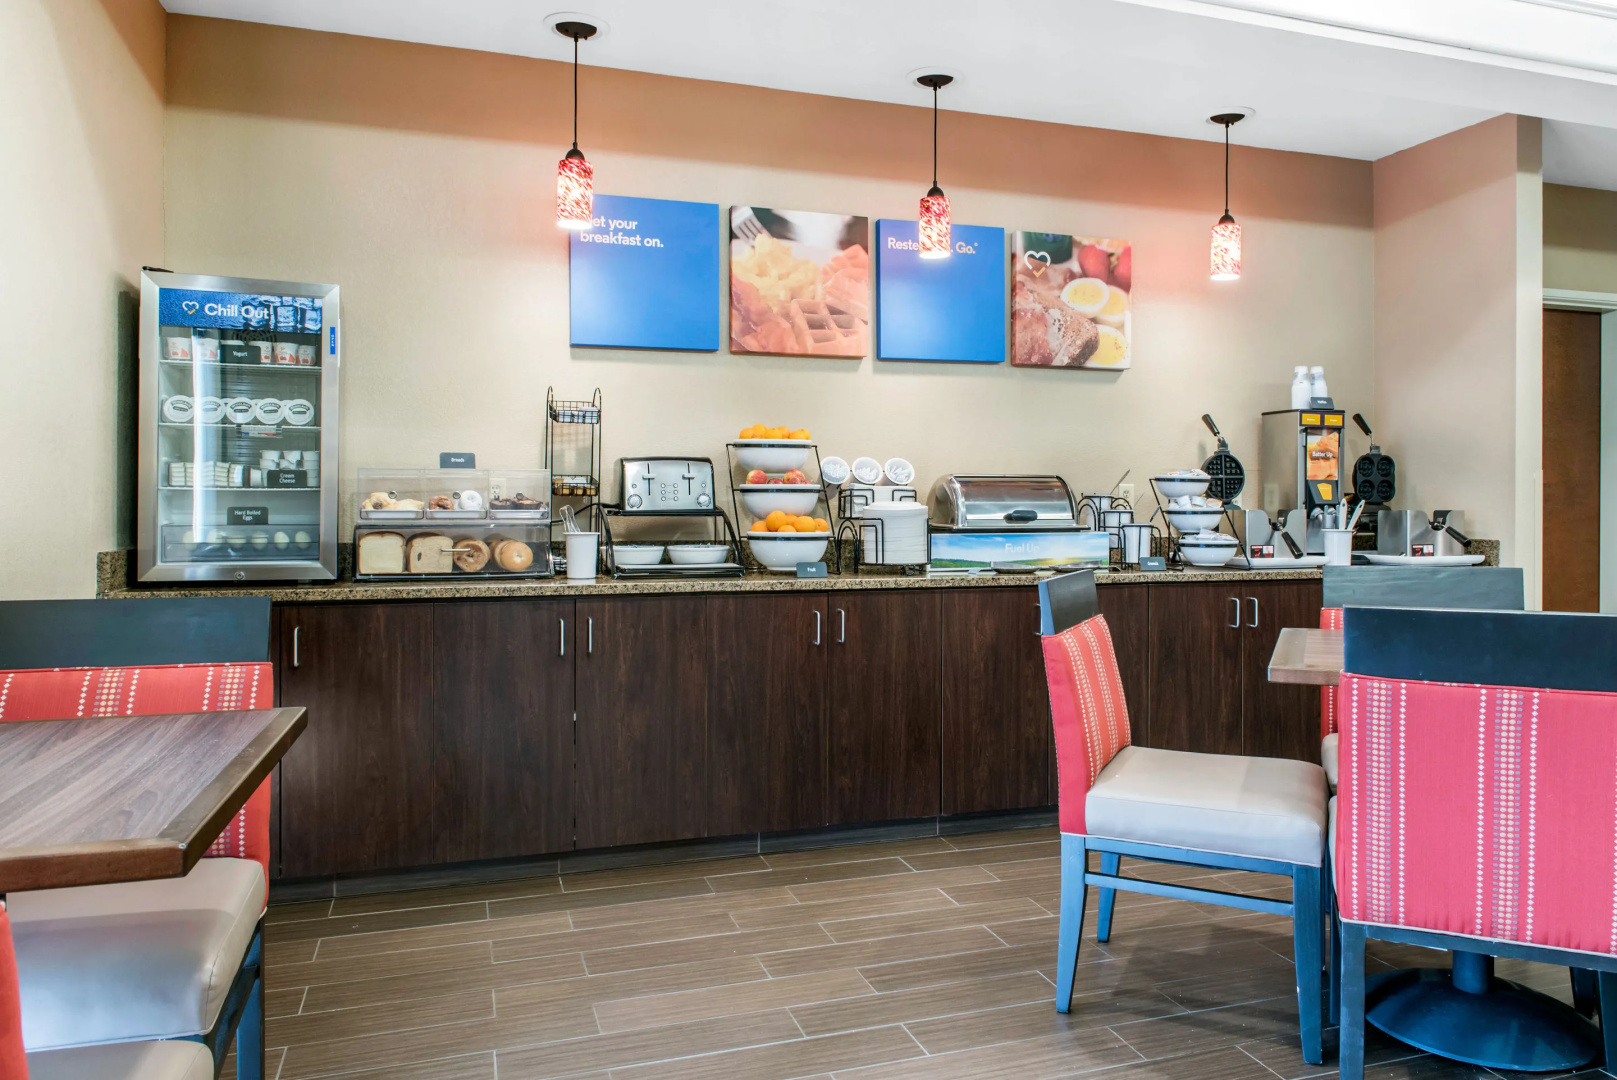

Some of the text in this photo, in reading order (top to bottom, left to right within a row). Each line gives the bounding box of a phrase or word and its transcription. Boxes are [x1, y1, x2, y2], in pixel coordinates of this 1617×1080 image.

[589, 216, 638, 230] et your
[580, 231, 664, 248] breakfast on.
[887, 237, 919, 250] Reste
[205, 303, 270, 319] Chill Out
[1005, 543, 1040, 554] Fuel Up
